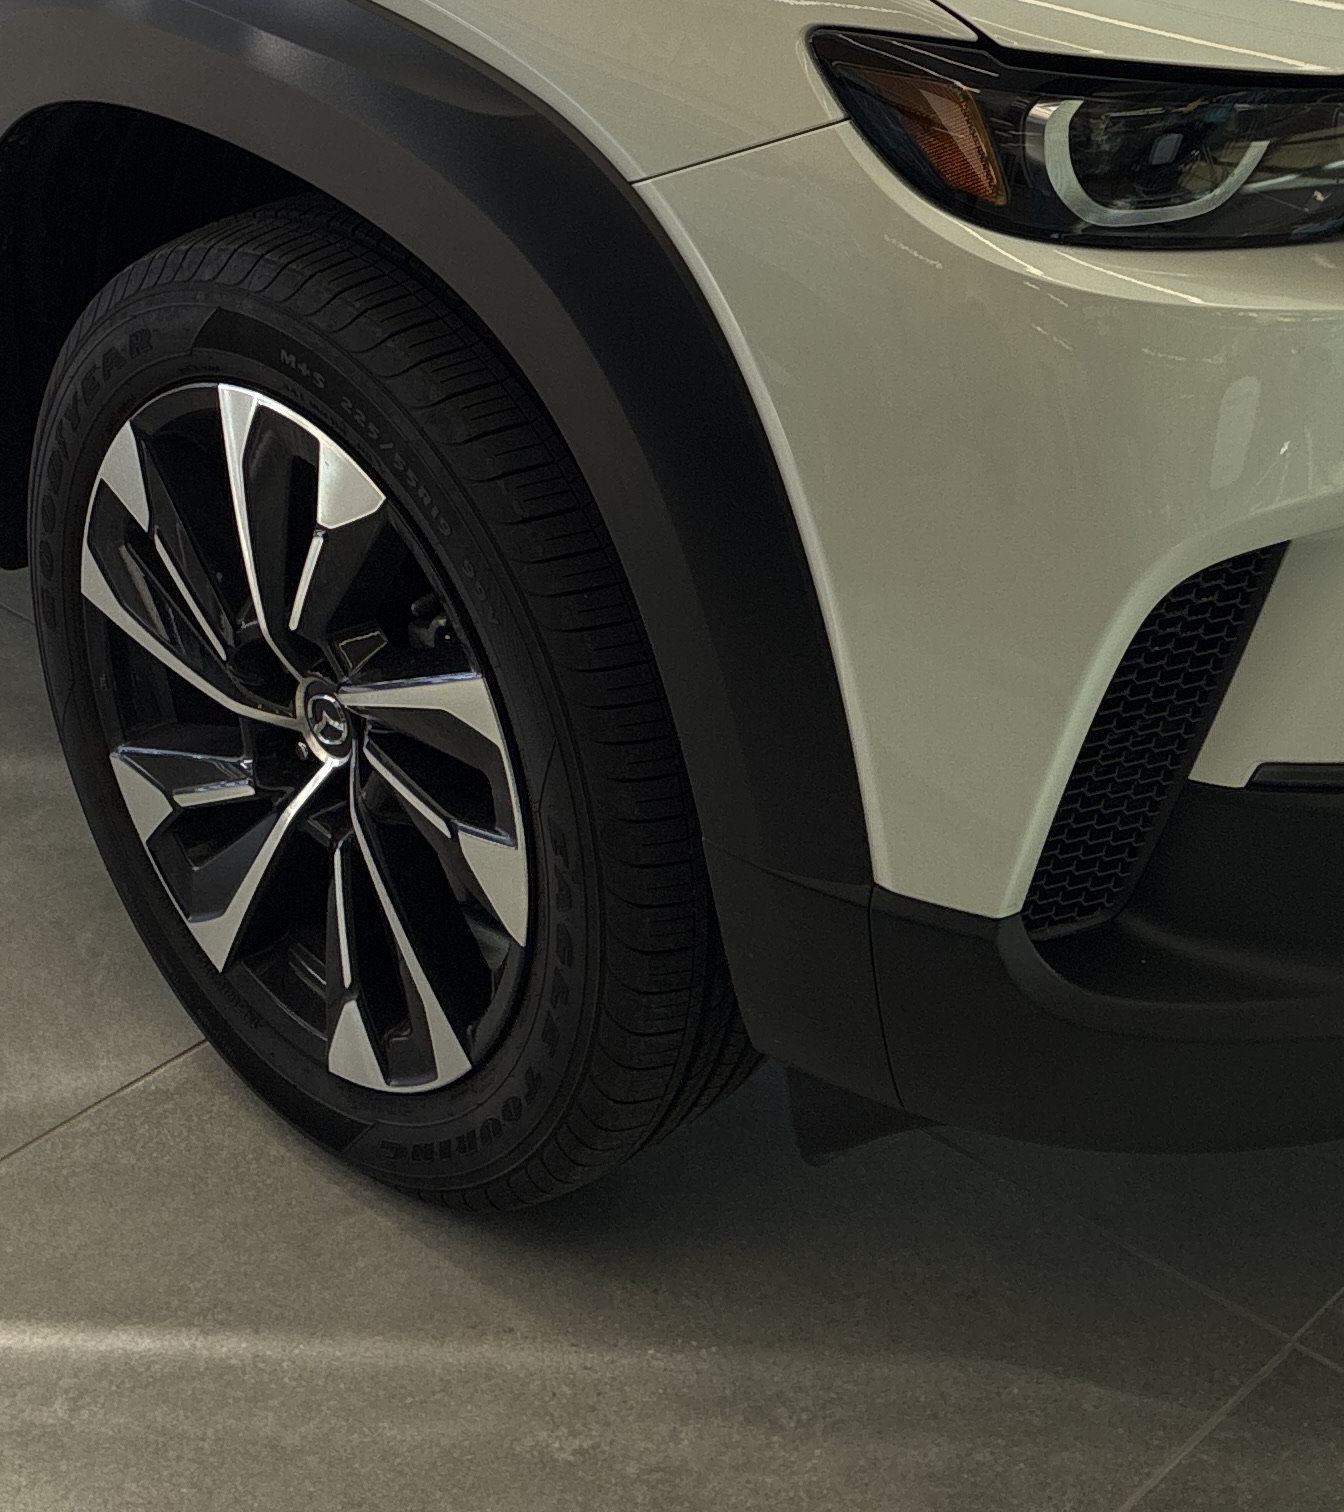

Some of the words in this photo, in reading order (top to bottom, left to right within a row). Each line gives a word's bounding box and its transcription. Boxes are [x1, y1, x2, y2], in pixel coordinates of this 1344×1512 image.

[38, 326, 155, 633] GOODYEAR
[278, 346, 326, 390] M+S
[339, 394, 453, 538] 225/55R19
[377, 1063, 543, 1164] TOURING
